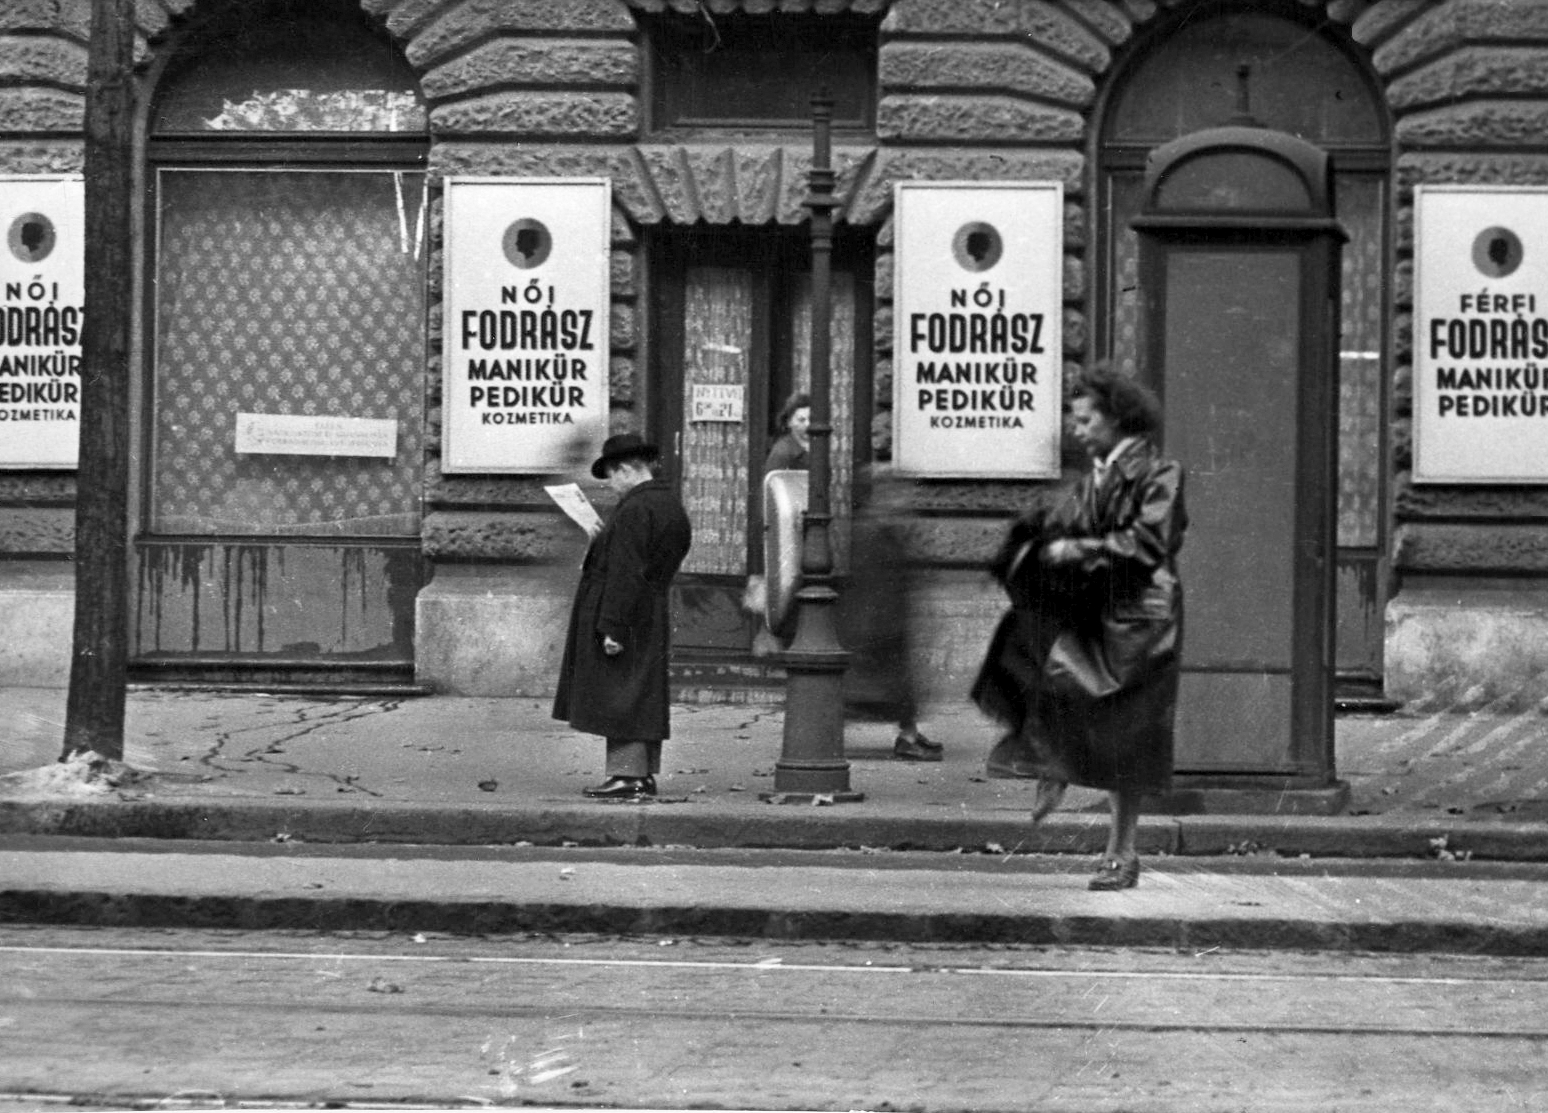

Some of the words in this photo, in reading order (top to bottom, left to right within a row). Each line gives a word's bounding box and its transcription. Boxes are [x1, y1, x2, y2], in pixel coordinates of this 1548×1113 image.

[6, 274, 58, 301] NŐI
[501, 278, 554, 304] NŐI
[951, 282, 1005, 308] NŐI
[1460, 287, 1536, 314] FÉRFI
[0, 301, 85, 347] DRÁS
[462, 305, 594, 351] FODRÁSZ
[910, 308, 1045, 354] FODRÁSZ
[468, 353, 587, 381] MANIKÜR
[916, 357, 1038, 385] MANIKÜR
[470, 381, 585, 408] PEDIKÜR
[918, 385, 1035, 412] PEDIKÜR
[482, 412, 574, 425] KOZMETIKA
[930, 416, 1024, 429] KOZMETIKA
